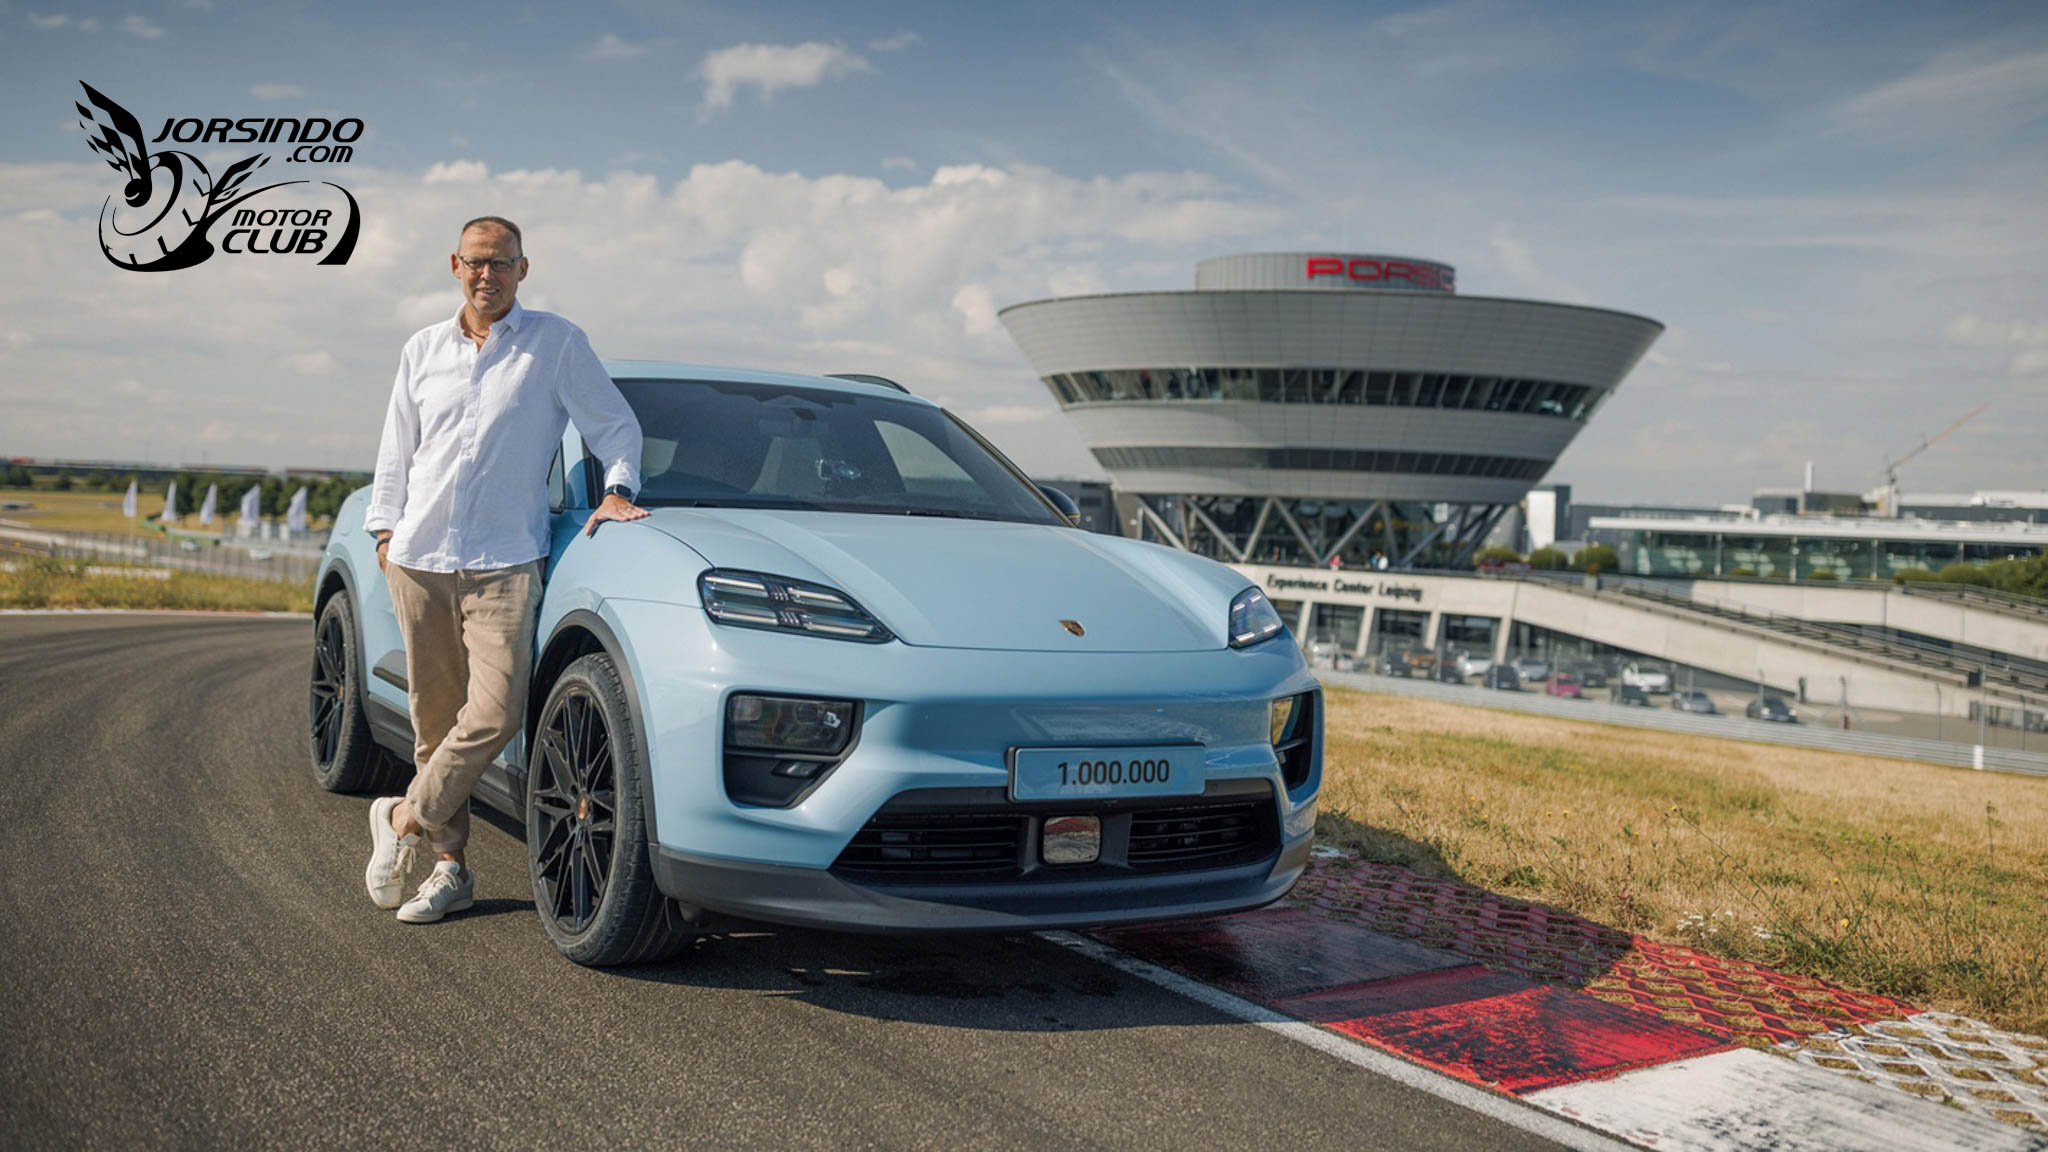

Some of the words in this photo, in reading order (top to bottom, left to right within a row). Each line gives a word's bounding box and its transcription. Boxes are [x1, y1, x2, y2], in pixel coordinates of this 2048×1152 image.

[1267, 574, 1328, 591] Experience
[1334, 579, 1373, 593] Center
[1378, 581, 1422, 601] Leipzig
[1057, 759, 1170, 785] 1.000.000
